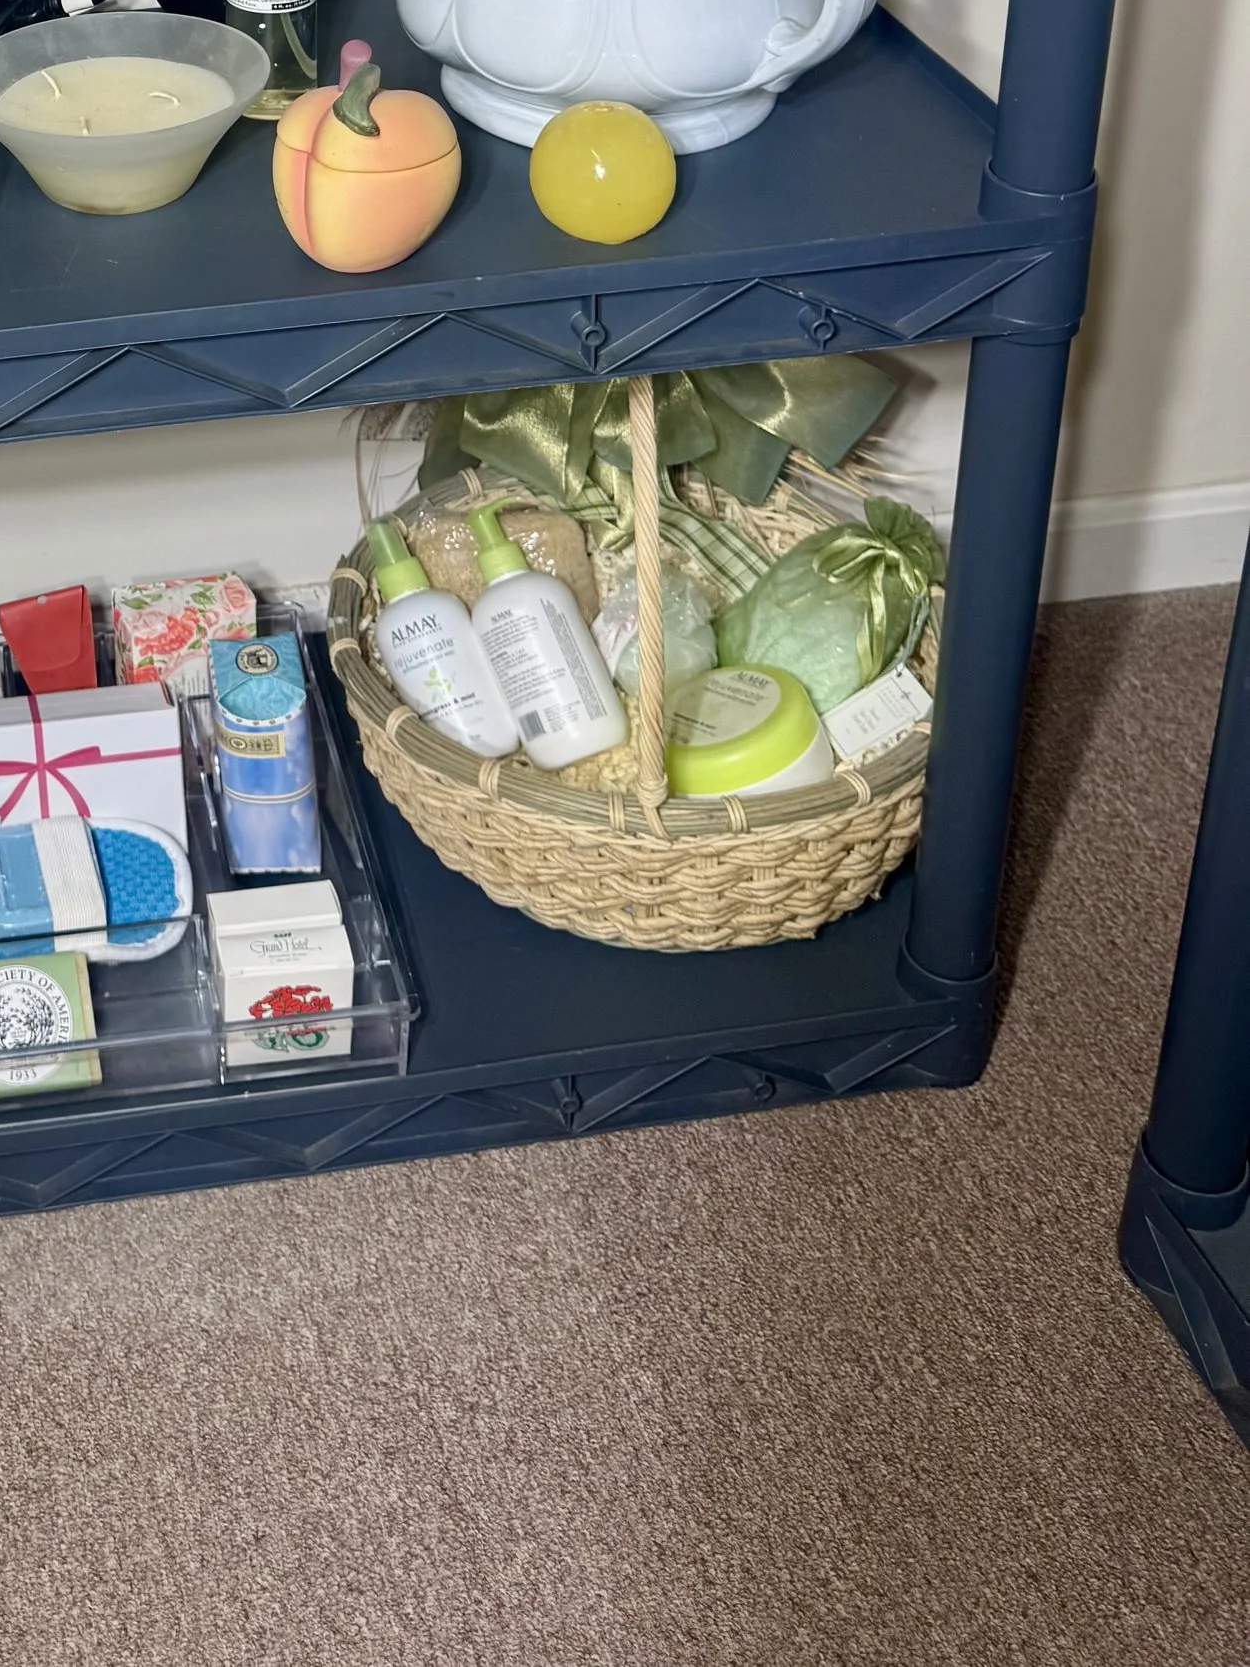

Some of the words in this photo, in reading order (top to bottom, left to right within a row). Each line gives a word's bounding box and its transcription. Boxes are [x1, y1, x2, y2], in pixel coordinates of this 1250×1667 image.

[390, 614, 438, 646] ALMAY
[250, 939, 282, 955] Grand
[38, 977, 56, 992] OF
[52, 995, 70, 1041] AMERI
[10, 1069, 37, 1081] 1933
